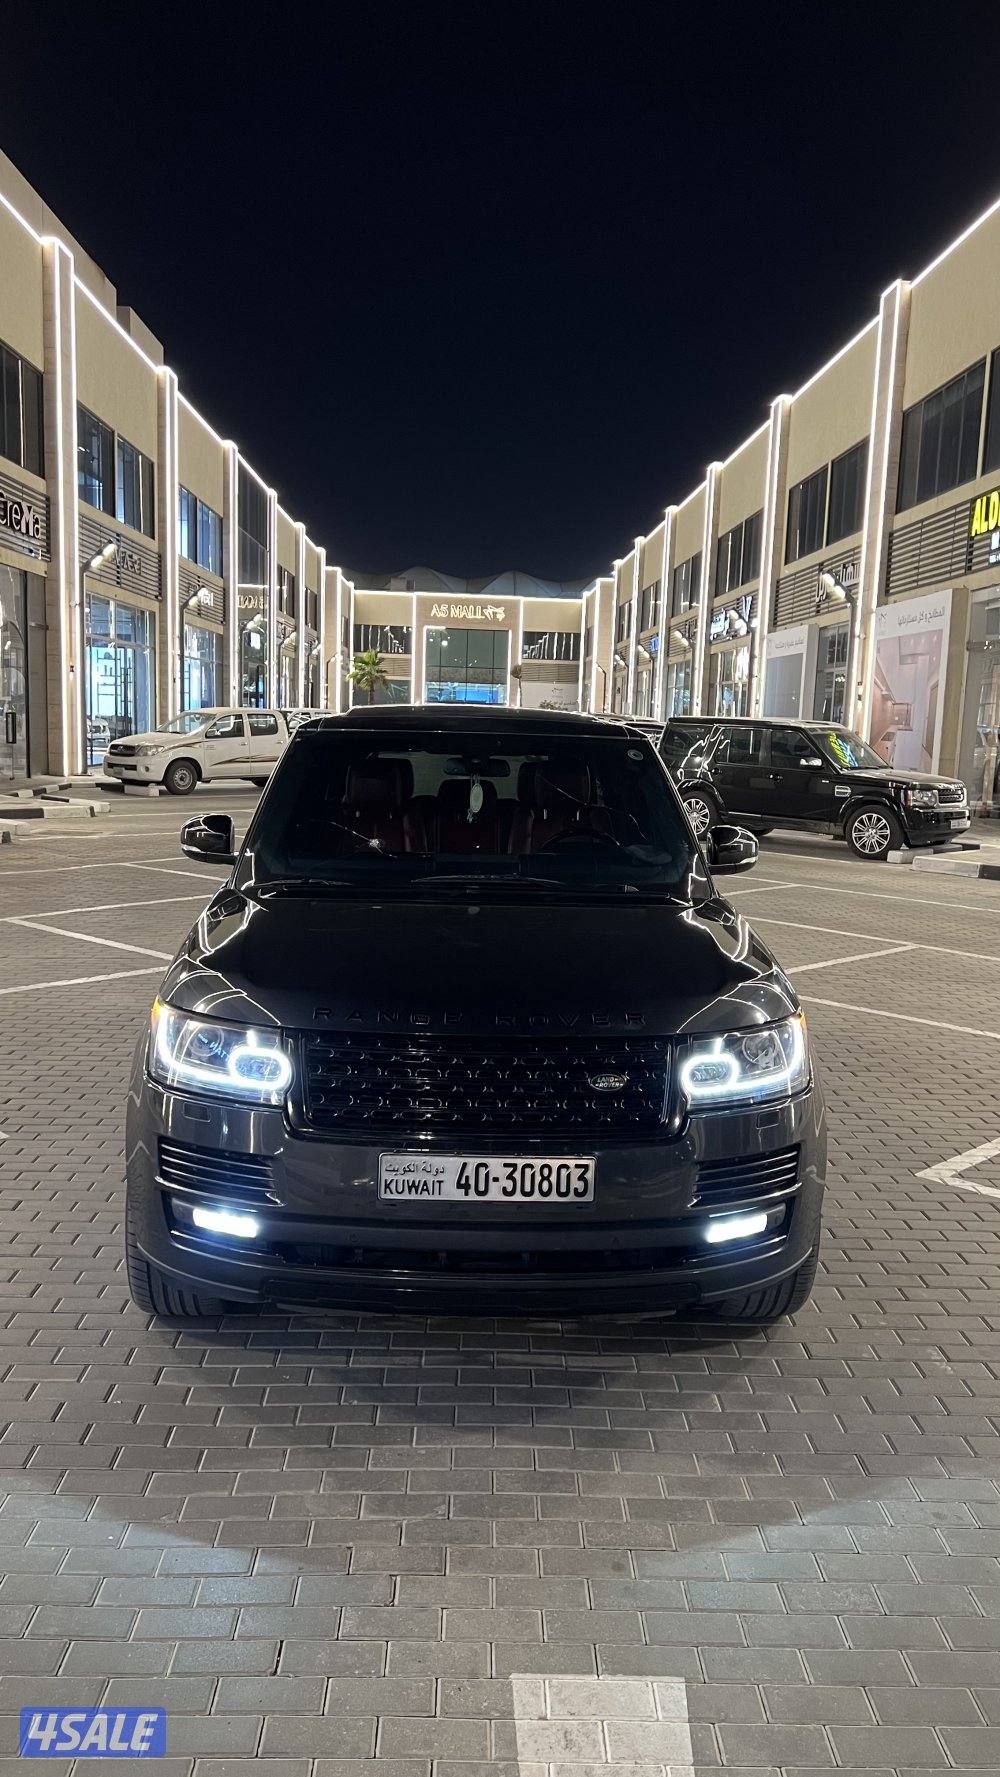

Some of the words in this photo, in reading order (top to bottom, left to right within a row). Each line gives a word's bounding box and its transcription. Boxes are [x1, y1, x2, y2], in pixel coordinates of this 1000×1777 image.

[450, 604, 486, 619] MALL
[494, 1012, 646, 1028] ROVER
[384, 1161, 418, 1177] الكويت
[421, 1160, 445, 1177] دولة
[383, 1178, 444, 1196] KUWAIT
[455, 1161, 590, 1198] 40-30803
